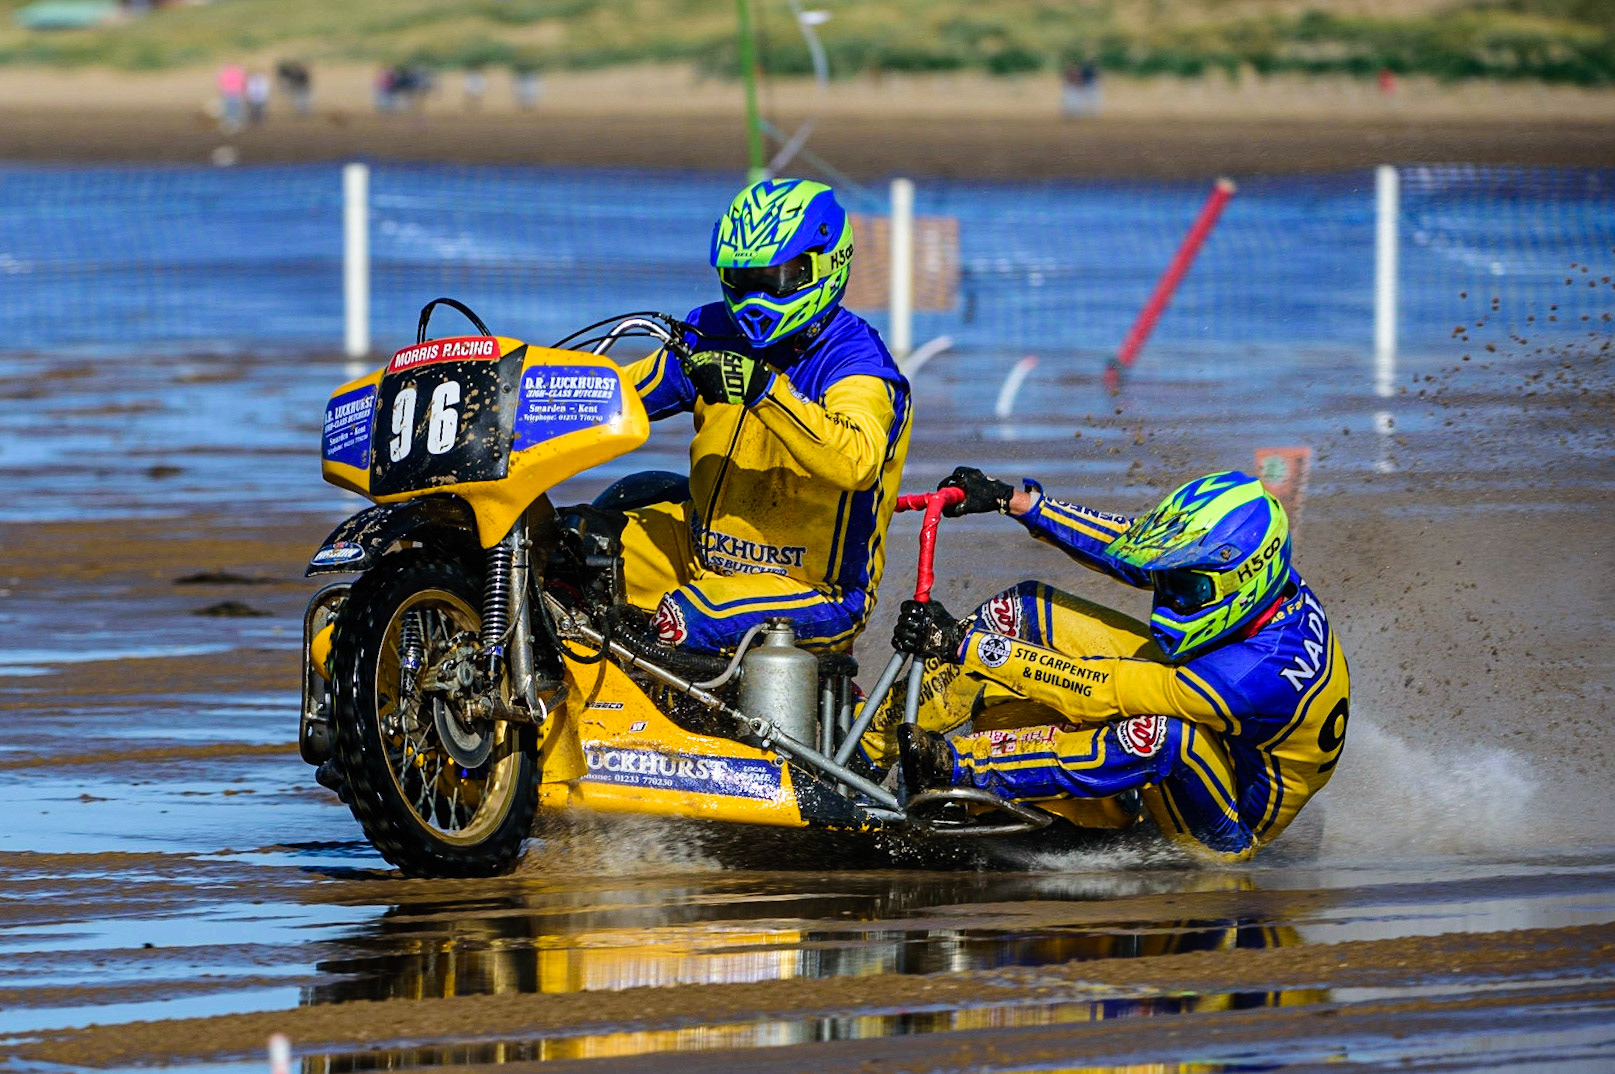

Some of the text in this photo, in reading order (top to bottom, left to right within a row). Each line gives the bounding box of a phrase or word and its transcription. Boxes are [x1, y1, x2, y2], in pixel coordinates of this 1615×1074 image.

[394, 340, 493, 368] MORRIS RACING
[525, 377, 617, 391] D.R. LUCKHURST
[573, 390, 614, 399] BUTCHERS
[335, 395, 375, 420] LUCKHURST
[529, 404, 566, 413] Smarden
[578, 404, 598, 413] Kent
[389, 380, 461, 463] 96
[703, 529, 807, 567] CKHURST
[1014, 647, 1109, 684] STB CARPENTRY
[1022, 666, 1092, 697] & BUILDING
[587, 750, 727, 780] UCKHURST
[742, 765, 768, 774] LOCAL
[614, 774, 640, 784] 01233
[642, 776, 673, 787] 770230
